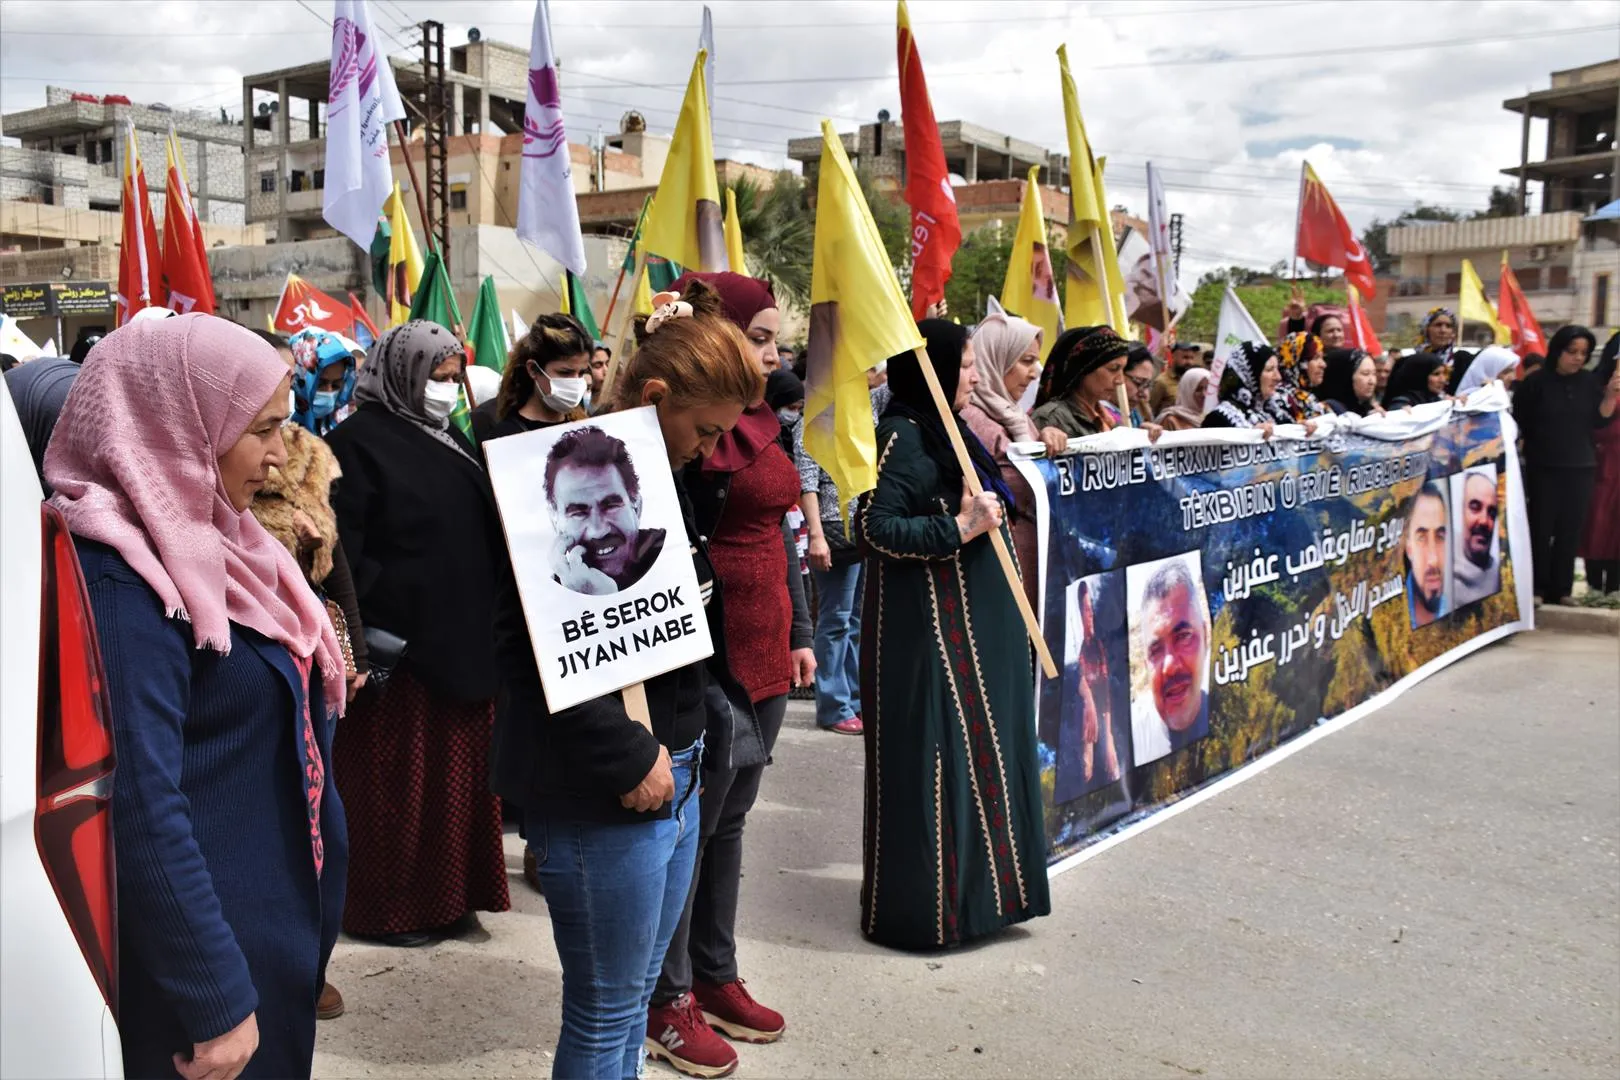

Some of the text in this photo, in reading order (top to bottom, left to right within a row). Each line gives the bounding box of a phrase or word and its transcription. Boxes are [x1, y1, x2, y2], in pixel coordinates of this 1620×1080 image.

[1223, 548, 1281, 602] عفرين
[561, 585, 685, 644] BÊ SEROK
[557, 613, 697, 679] JIYAN NABE
[1213, 627, 1276, 686] عفرين
